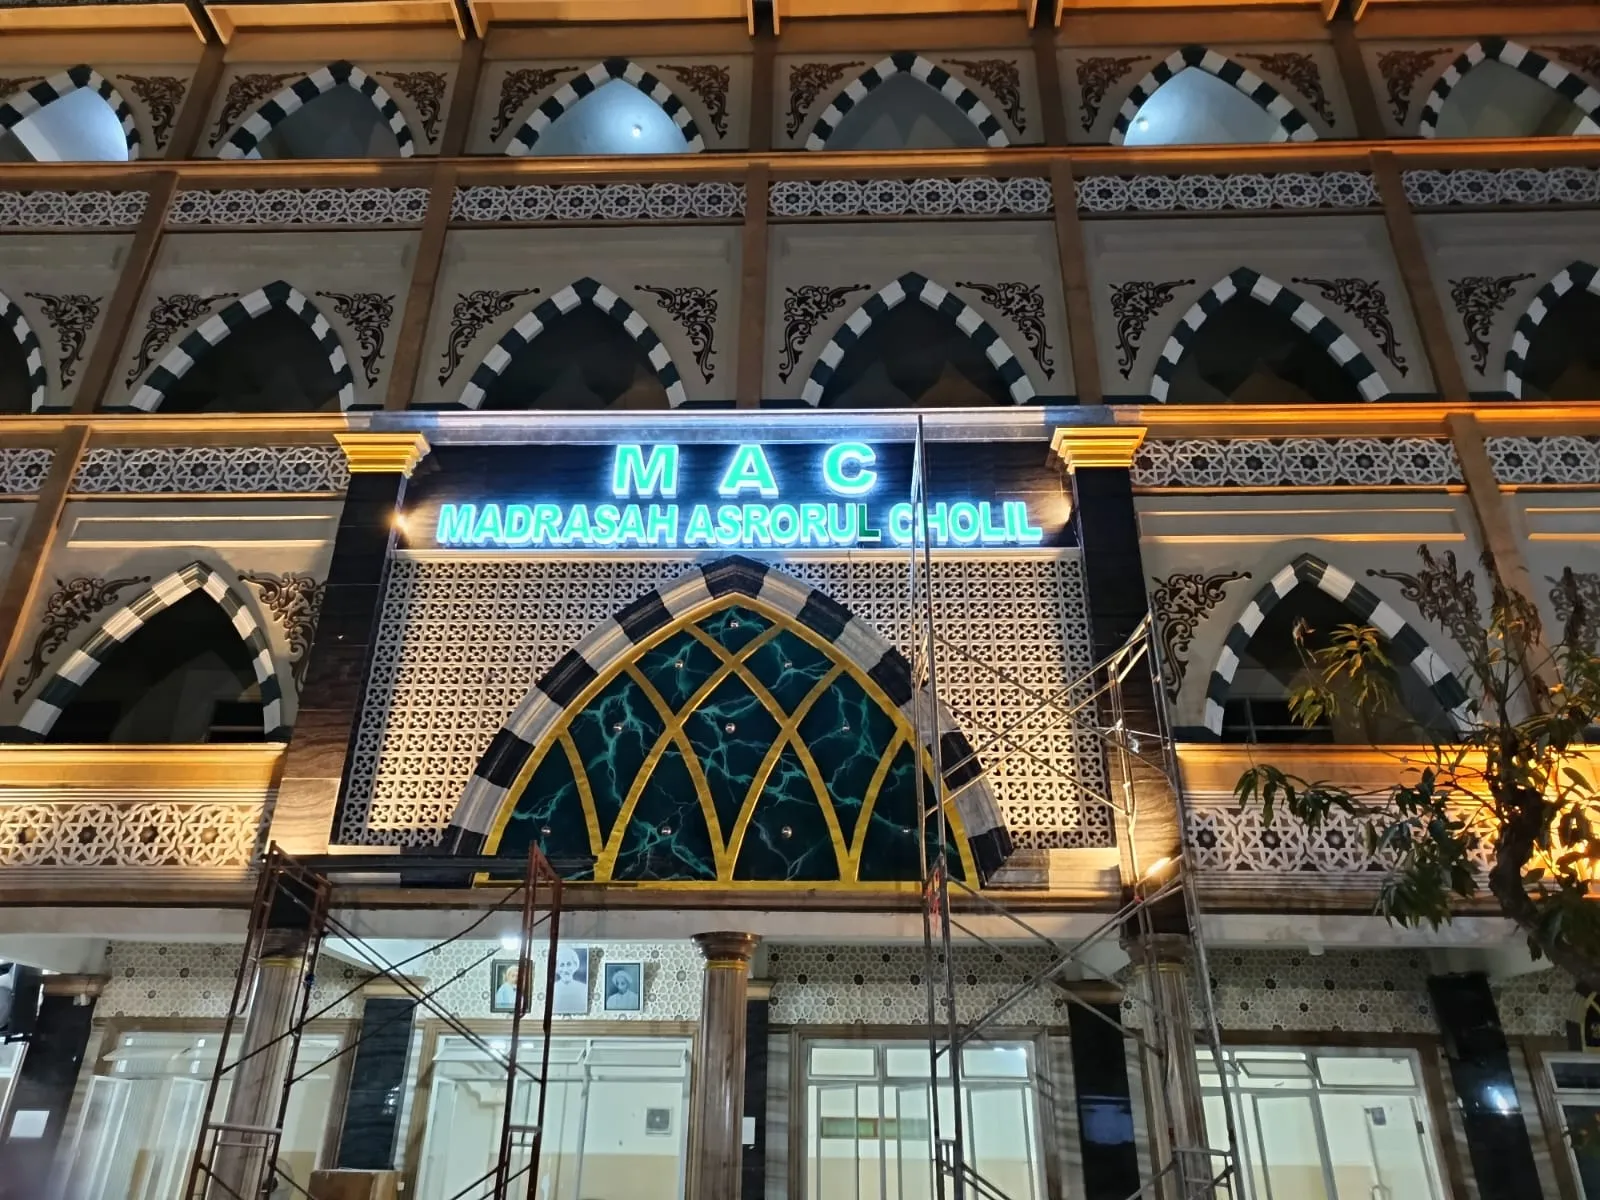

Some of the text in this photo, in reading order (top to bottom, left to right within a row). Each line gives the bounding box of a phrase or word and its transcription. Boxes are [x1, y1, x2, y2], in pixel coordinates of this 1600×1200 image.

[436, 501, 1044, 545] MADRASAH ASRORUL CHOLIL
